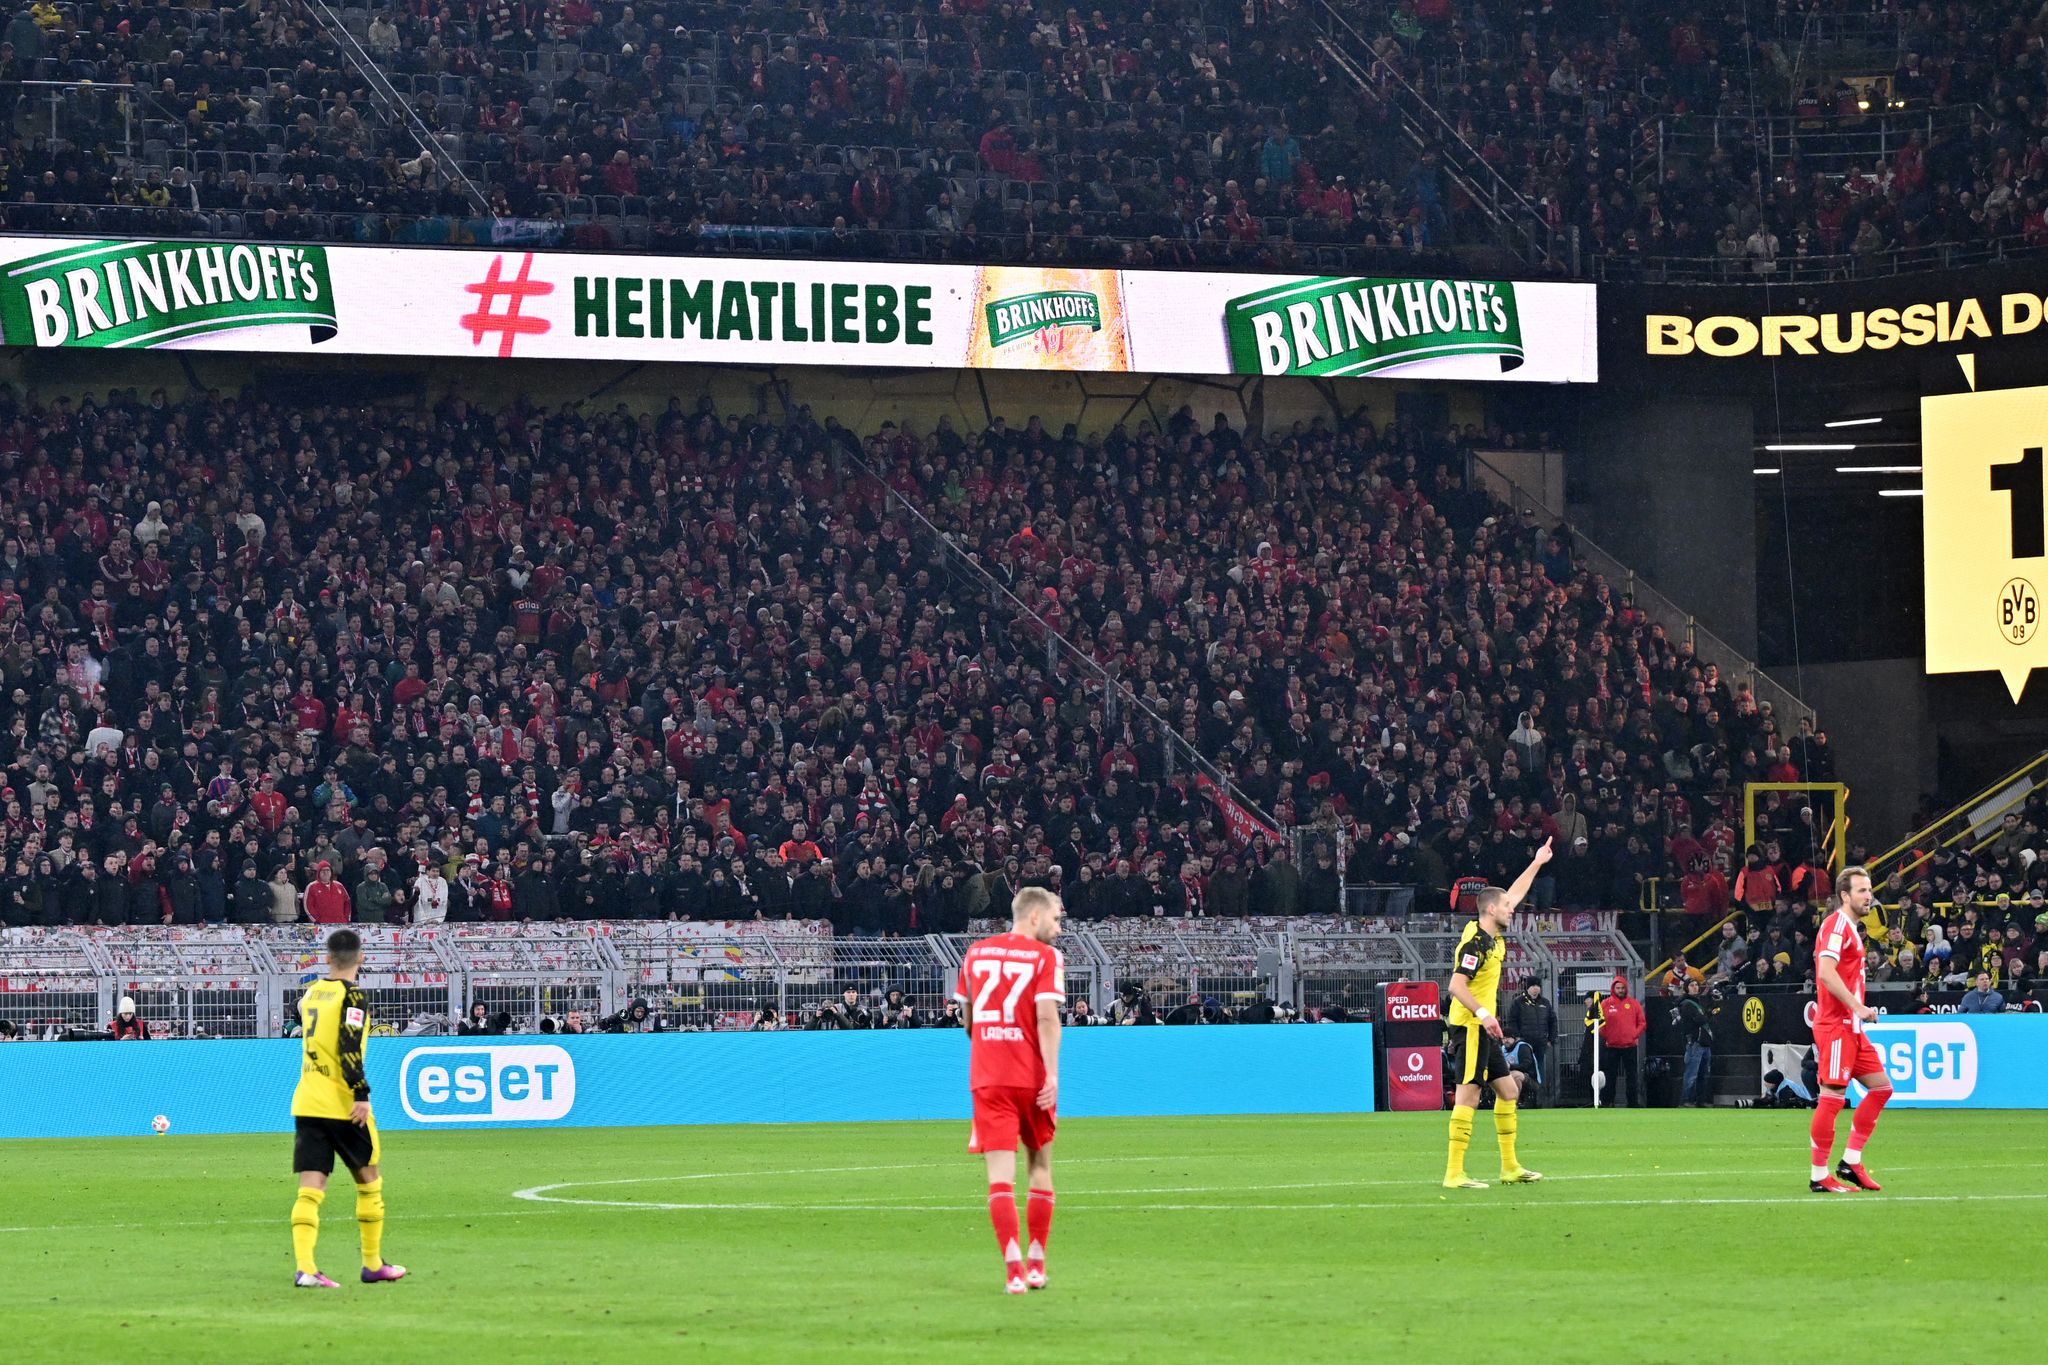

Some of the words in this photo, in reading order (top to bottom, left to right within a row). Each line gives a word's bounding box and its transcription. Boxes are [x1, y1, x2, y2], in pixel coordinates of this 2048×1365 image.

[23, 245, 319, 348] BRINKHOFF's
[995, 296, 1097, 336] BRINKHOFF's
[1251, 280, 1508, 376] BRINKHOFF's
[1646, 298, 1992, 357] BORUSSIA
[2001, 292, 2048, 335] D
[1990, 447, 2046, 560] 1
[2003, 583, 2036, 626] BVB
[2013, 624, 2025, 639] 09
[1460, 881, 1486, 890] atlas
[972, 960, 1035, 1024] 27
[1387, 996, 1408, 1005] SPEED
[1391, 1004, 1438, 1019] CHECK
[1745, 1001, 1762, 1022] BVB
[1399, 1072, 1433, 1082] vodafone
